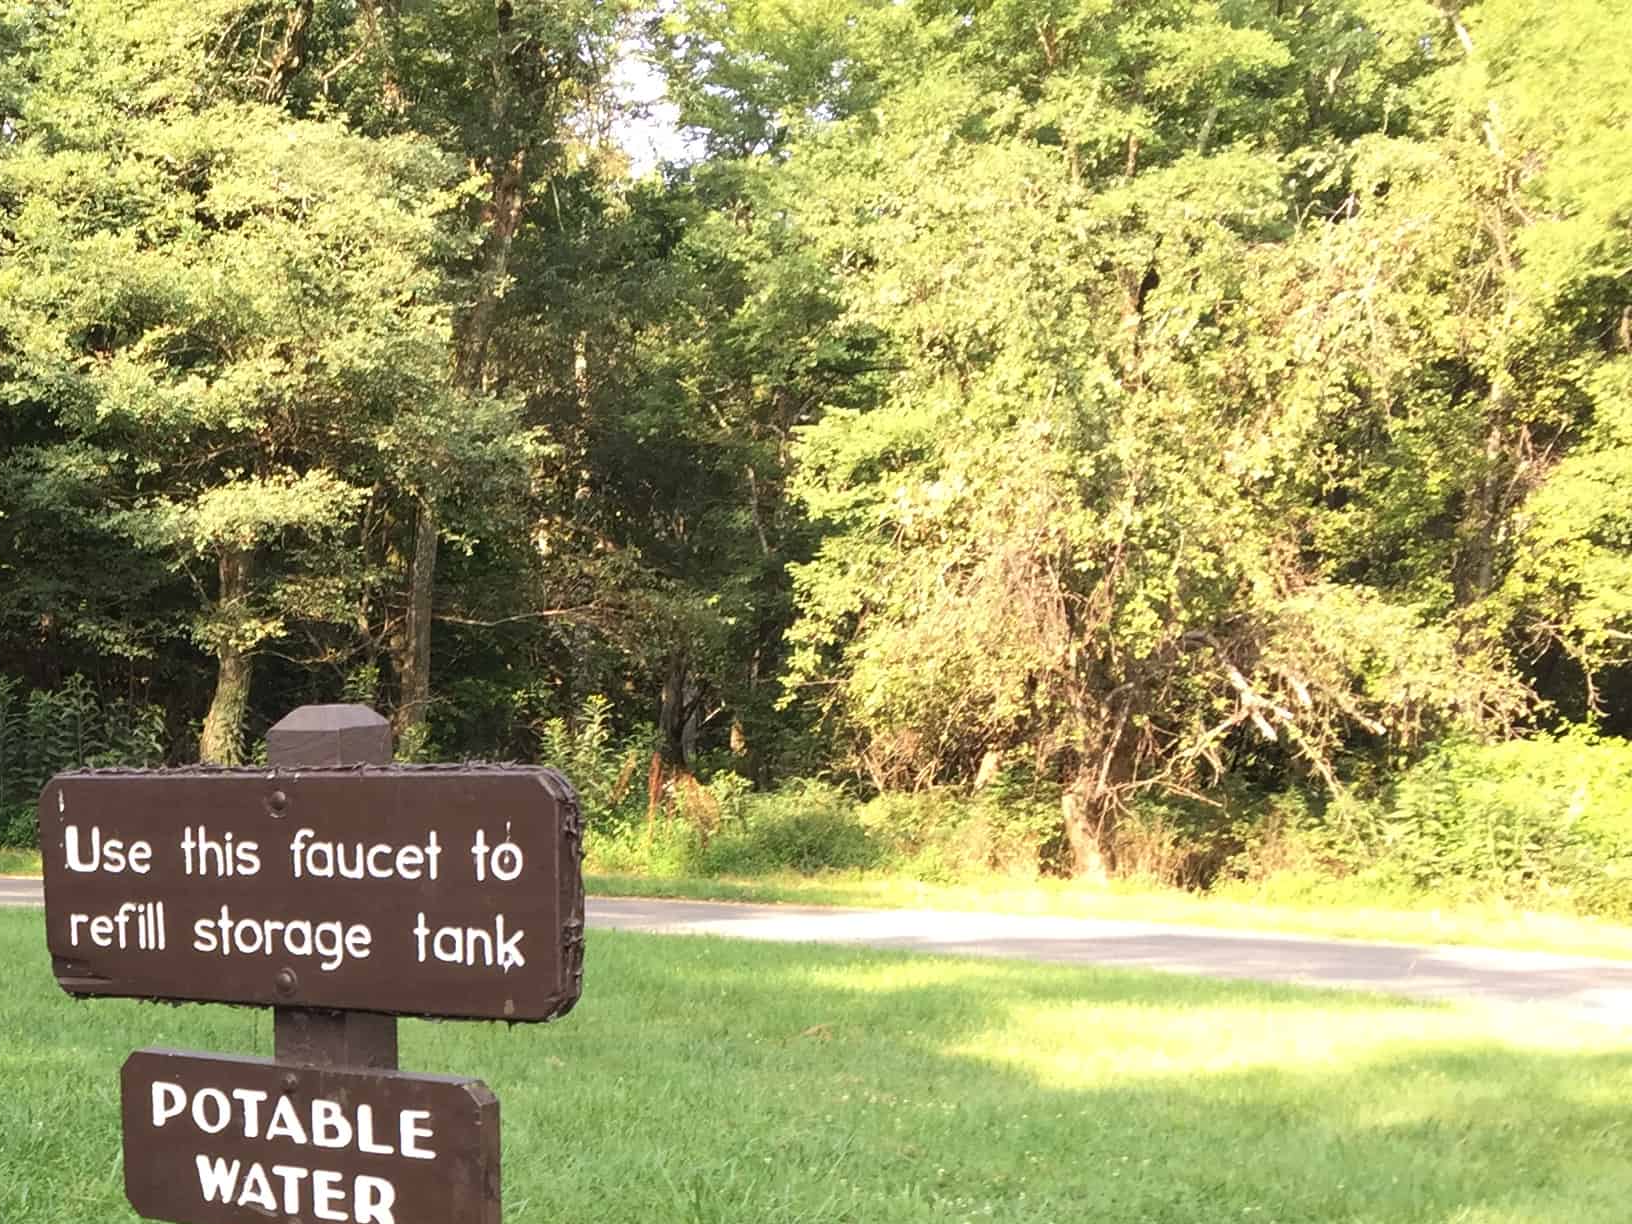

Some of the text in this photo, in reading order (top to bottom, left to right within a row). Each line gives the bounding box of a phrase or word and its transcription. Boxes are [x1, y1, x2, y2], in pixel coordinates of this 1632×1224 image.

[65, 826, 522, 881] Use this faucet to
[69, 902, 525, 970] refill storage tank
[151, 1081, 437, 1159] POTABLE
